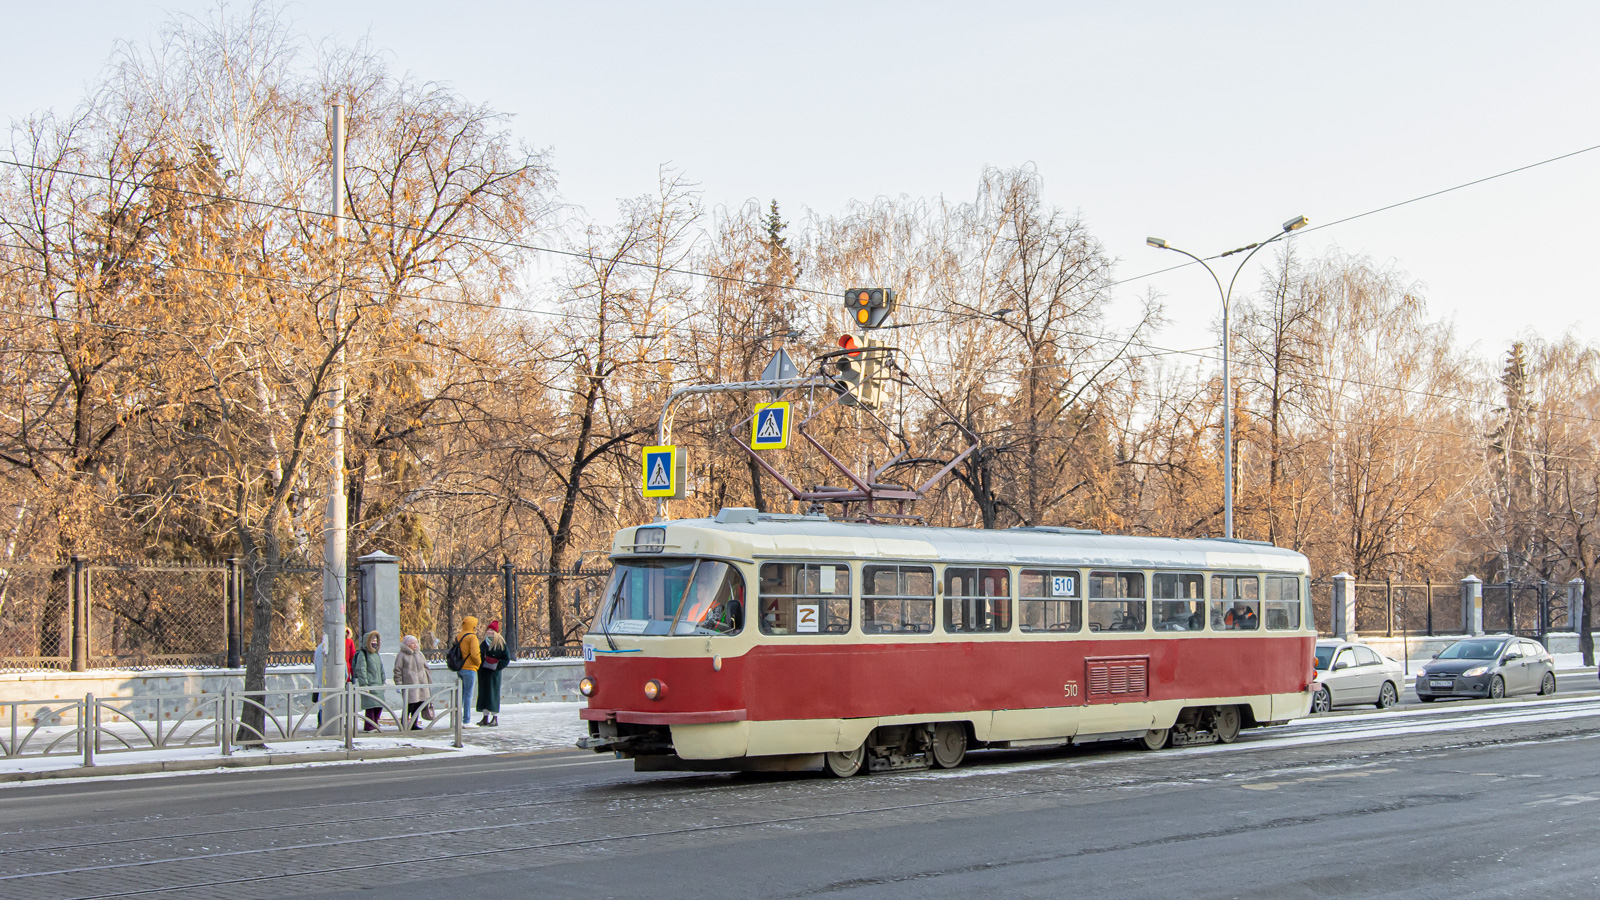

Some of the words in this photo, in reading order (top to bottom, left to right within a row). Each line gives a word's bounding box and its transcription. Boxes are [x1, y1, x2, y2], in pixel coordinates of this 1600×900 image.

[645, 531, 661, 551] 15
[1055, 578, 1072, 591] 510
[800, 608, 816, 623] Z
[1064, 684, 1078, 697] 510
